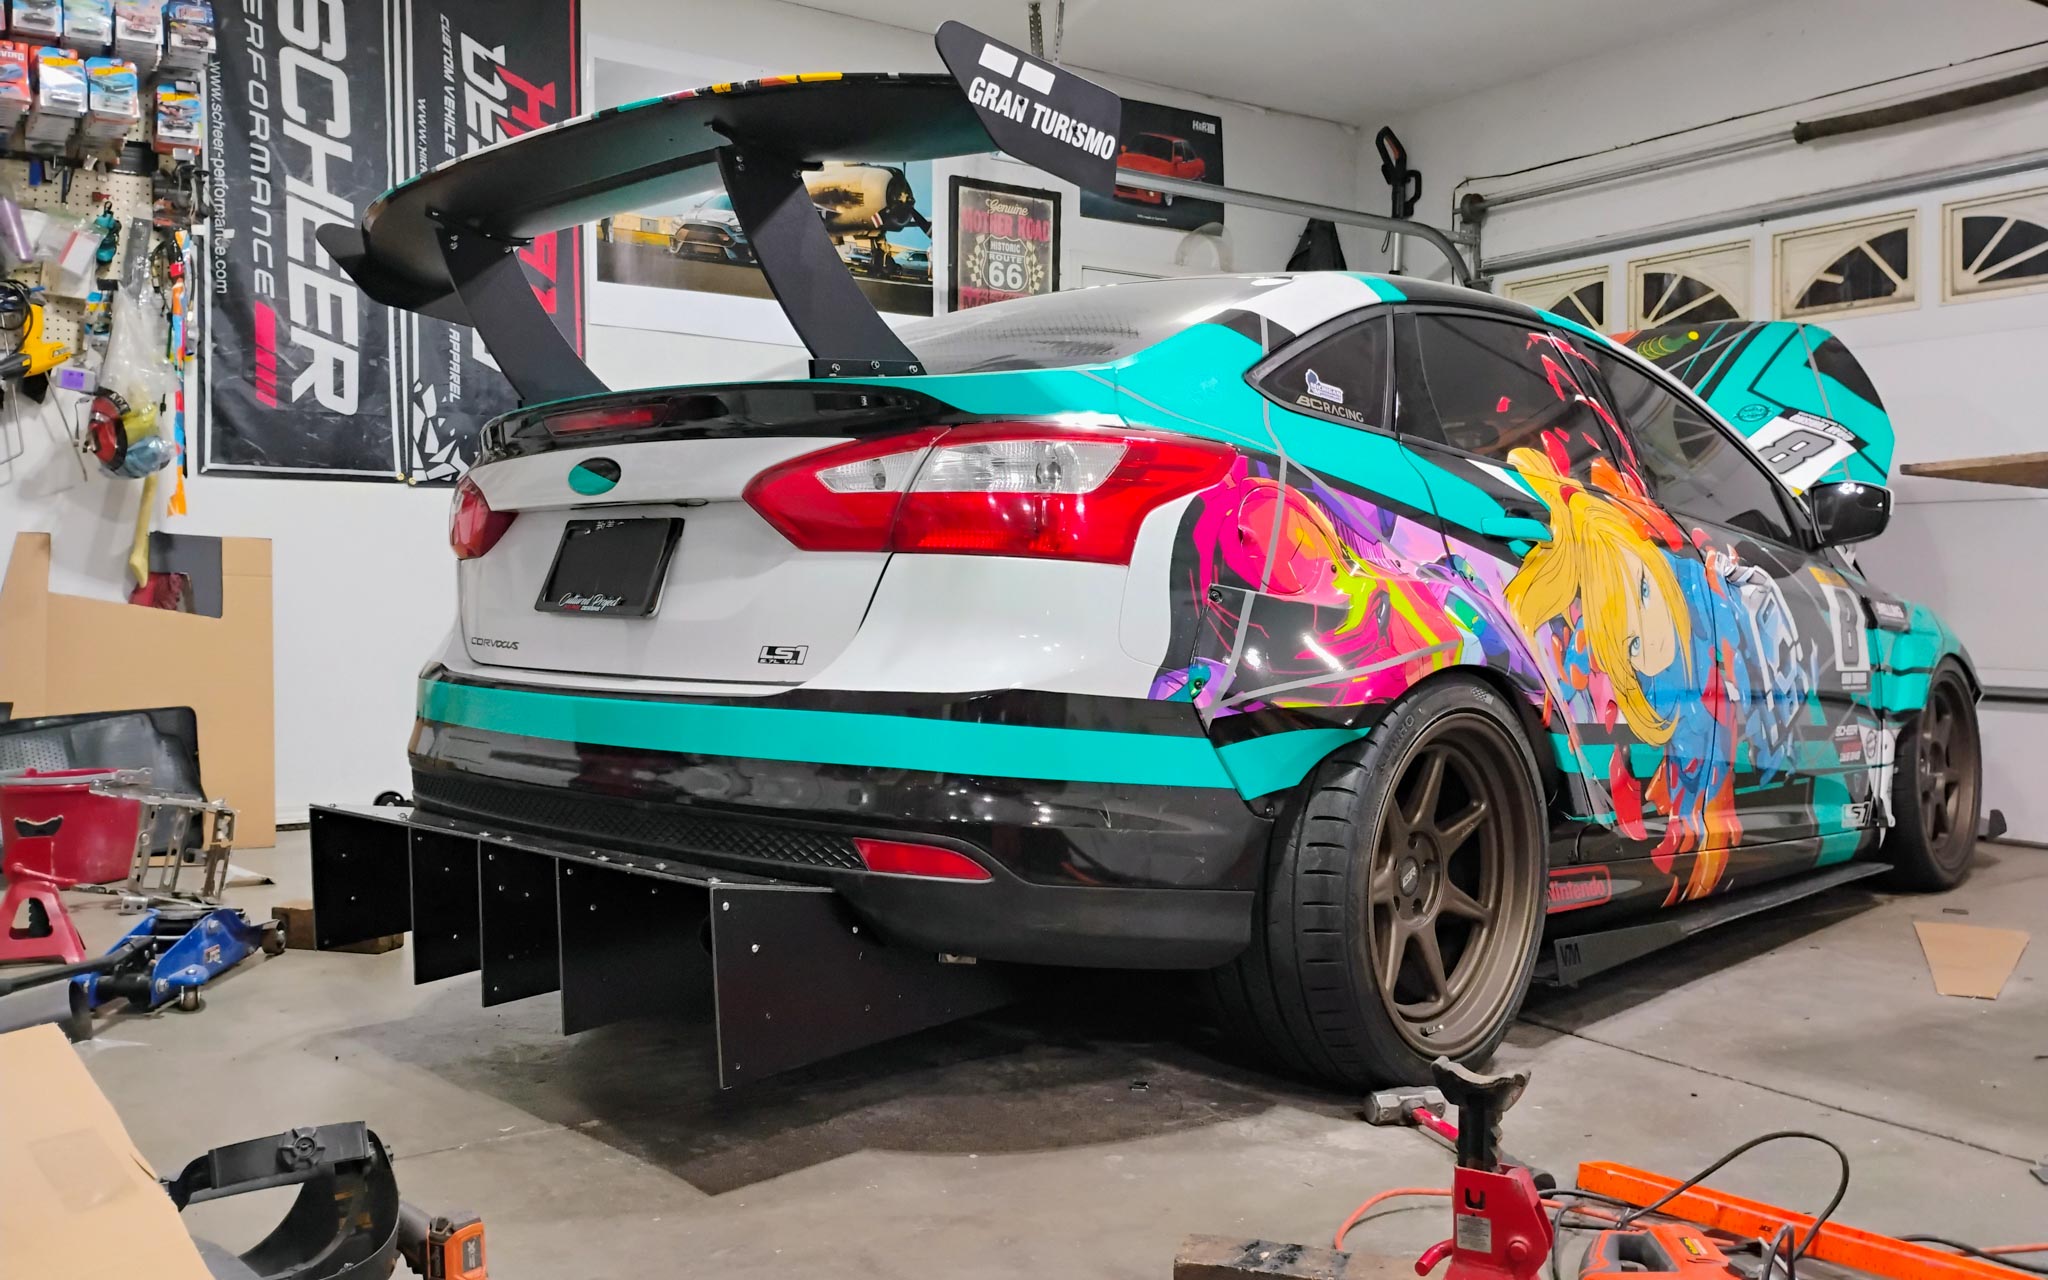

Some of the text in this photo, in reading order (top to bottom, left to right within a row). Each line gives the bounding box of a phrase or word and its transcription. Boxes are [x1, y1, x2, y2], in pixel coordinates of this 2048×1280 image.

[439, 13, 456, 157] CUSTOM VEHICLE
[968, 76, 1116, 160] GRAN TURISMO
[209, 61, 228, 294] www.scheer-performance.com
[985, 199, 1028, 216] Genuine
[1018, 214, 1050, 242] ROAD
[989, 253, 1023, 264] ROUTE
[990, 240, 1021, 254] HISTORIC
[988, 261, 1023, 289] 66
[449, 328, 461, 402] APPAREL
[760, 645, 808, 665] LS1
